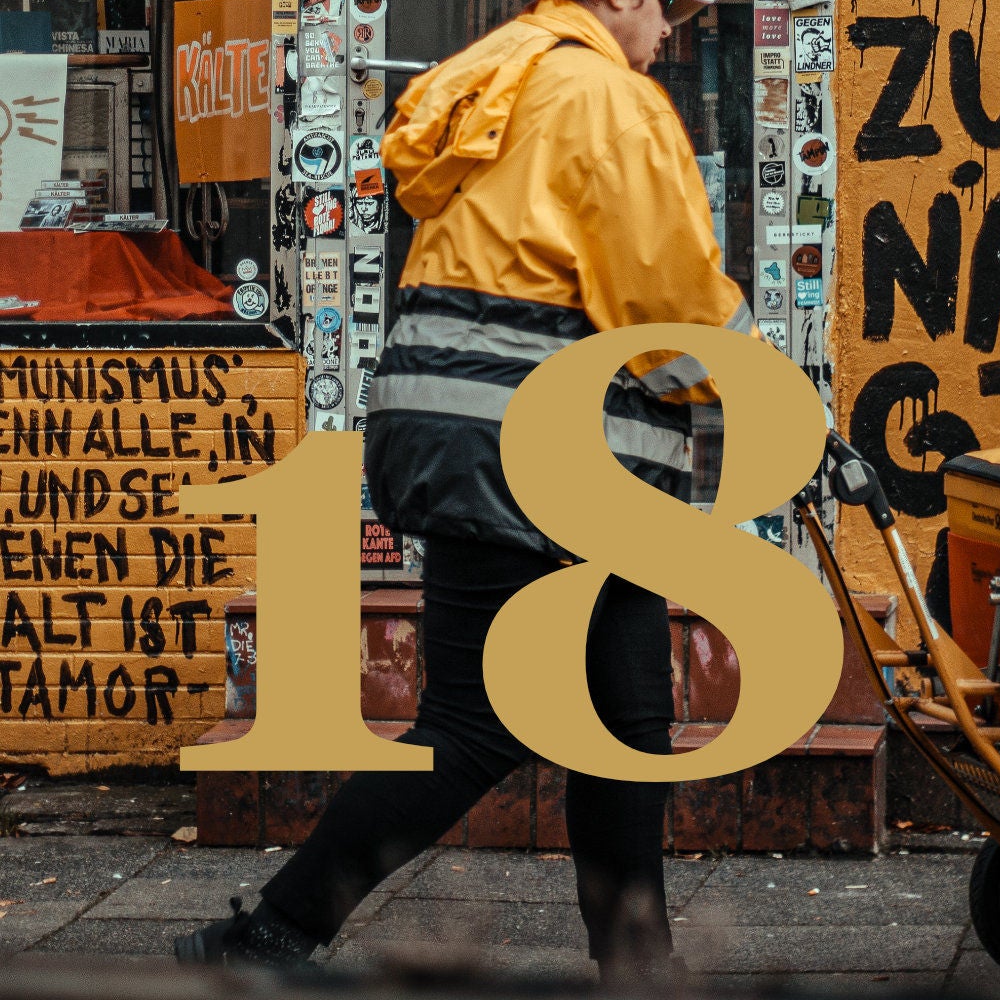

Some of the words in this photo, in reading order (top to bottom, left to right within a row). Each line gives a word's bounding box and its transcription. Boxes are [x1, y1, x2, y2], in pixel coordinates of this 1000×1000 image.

[795, 18, 830, 27] GEGEN
[52, 31, 79, 40] VISTA
[52, 44, 94, 53] CHINESA
[797, 61, 832, 71] LINDNER
[177, 31, 271, 122] KÄLTE
[305, 259, 338, 267] BRMEN
[306, 285, 338, 293] ORNGE
[797, 281, 819, 290] Still
[222, 411, 276, 465] IN
[20, 466, 111, 522] UND
[362, 537, 394, 550] KANTE
[150, 526, 234, 589] DIE
[361, 553, 383, 564] EGEN
[384, 553, 402, 563] AFD
[121, 594, 212, 657] IST
